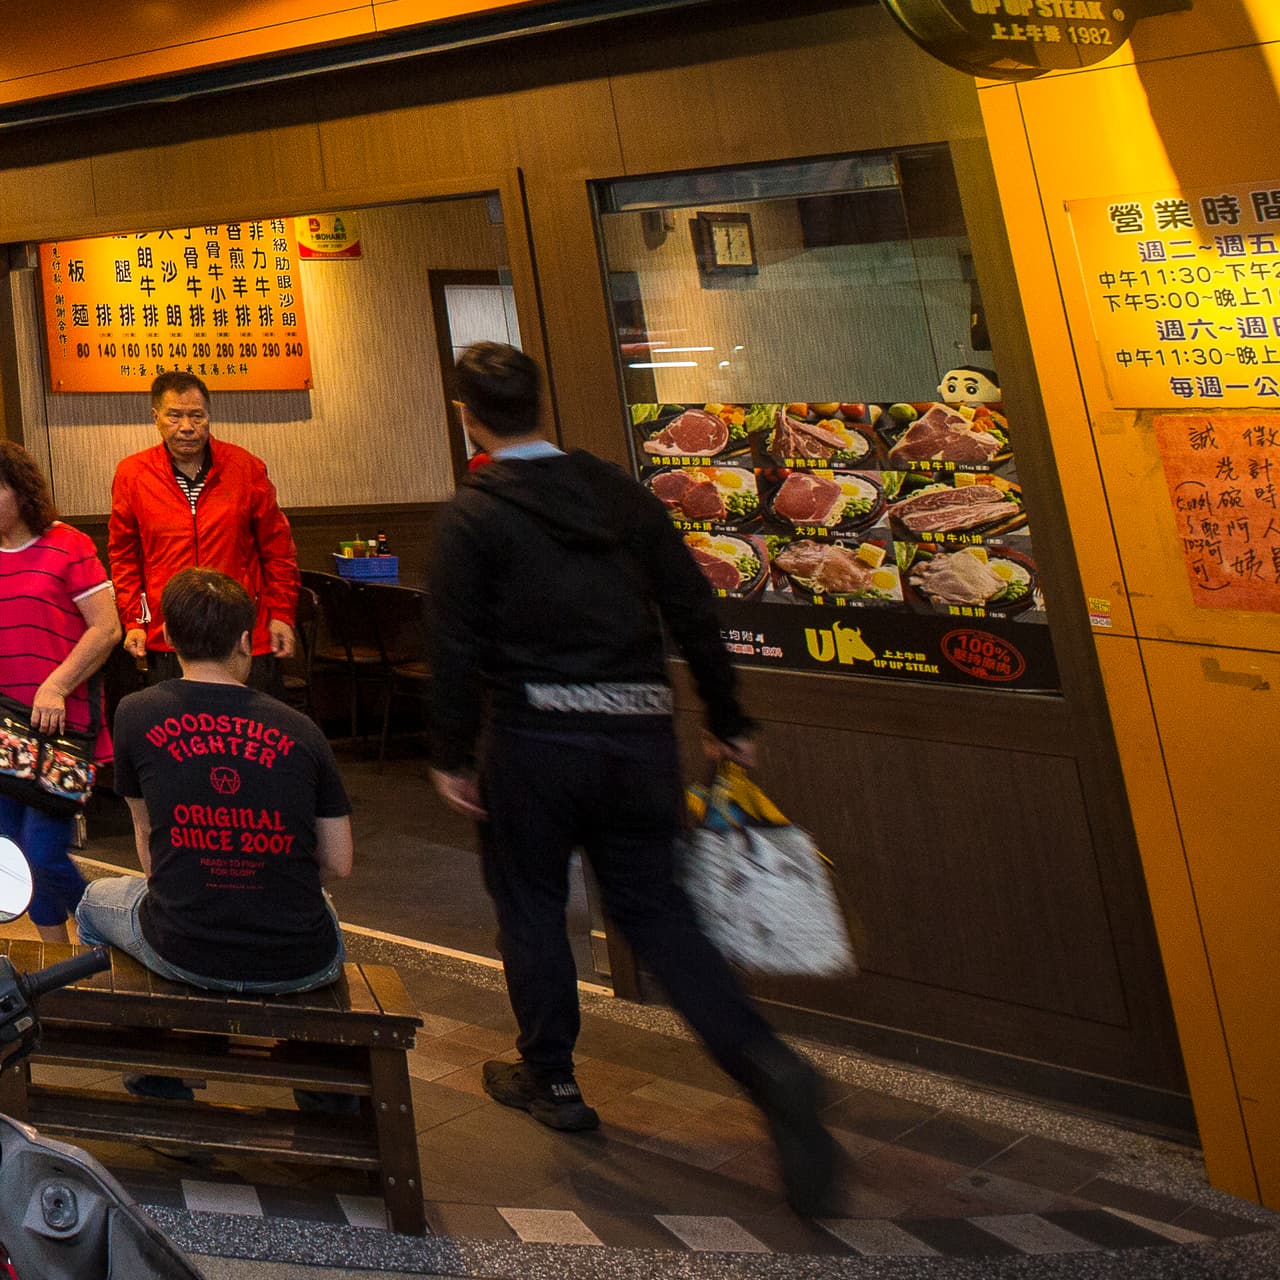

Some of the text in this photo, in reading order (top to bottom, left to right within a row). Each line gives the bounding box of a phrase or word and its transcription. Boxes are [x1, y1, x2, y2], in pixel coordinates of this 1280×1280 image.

[991, 22, 1113, 46] 上上牛排 1982
[1103, 287, 1280, 313] 下午5:00~晚上1
[76, 342, 304, 359] 80 140 160 150 240 280 280 280 290 340
[873, 659, 940, 674] UP UP STEAK
[145, 712, 296, 756] WOODSTUCK
[167, 734, 277, 769] FIGHTER
[173, 803, 287, 831] ORIGINAL
[170, 826, 296, 856] SINCE 2007
